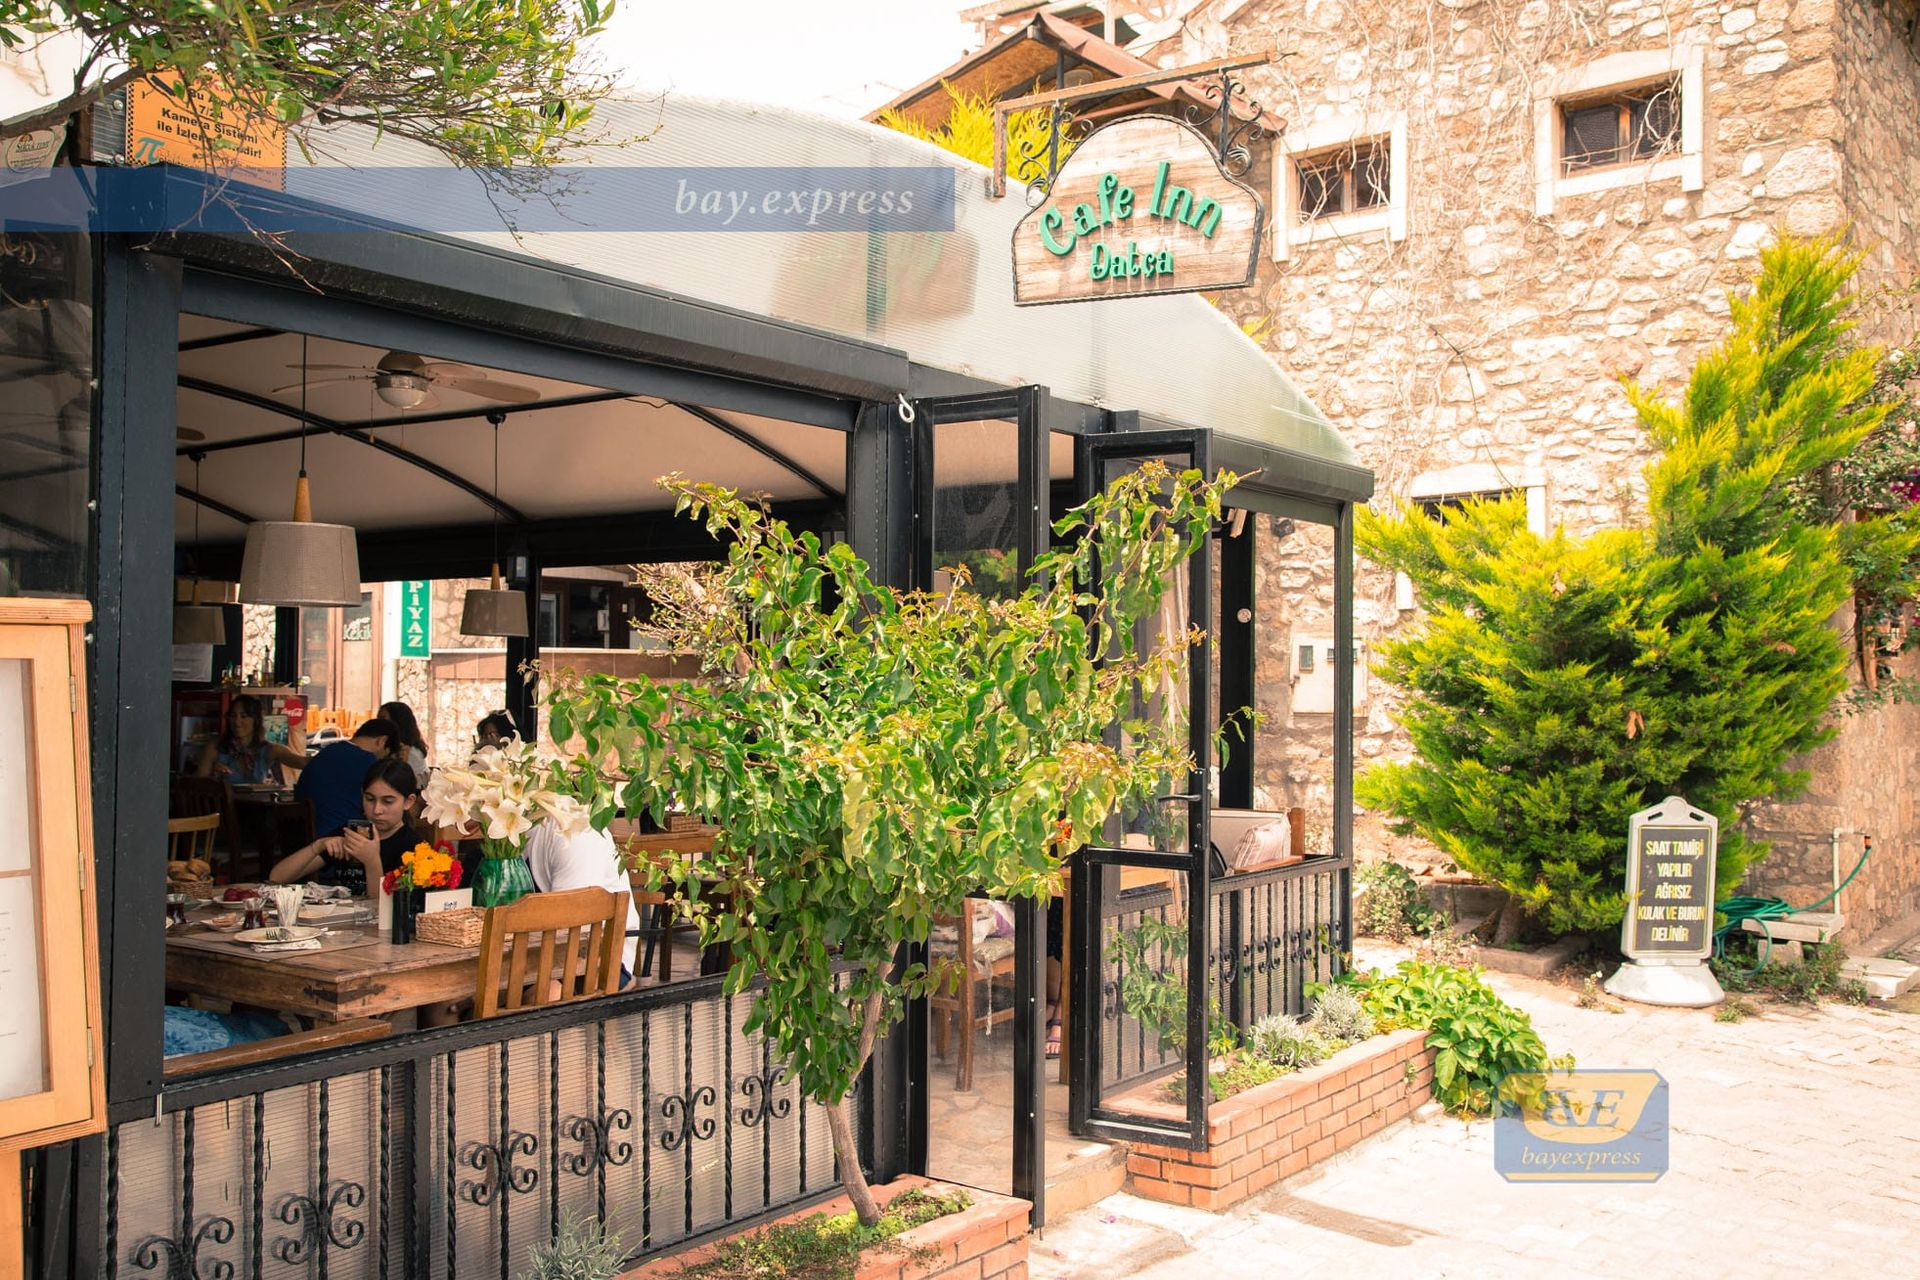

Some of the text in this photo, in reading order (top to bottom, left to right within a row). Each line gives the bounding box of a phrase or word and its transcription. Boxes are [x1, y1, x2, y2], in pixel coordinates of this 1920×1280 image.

[157, 120, 173, 133] ile
[1039, 160, 1223, 256] Cafe Inn
[1089, 240, 1175, 281] Datça
[1646, 840, 1671, 856] SAAT
[1657, 863, 1692, 877] YAPILIR
[1655, 882, 1692, 899] AĞRISIZ
[1637, 906, 1665, 920] KULAK
[1666, 906, 1677, 920] VE
[1651, 925, 1689, 941] DELİNİR
